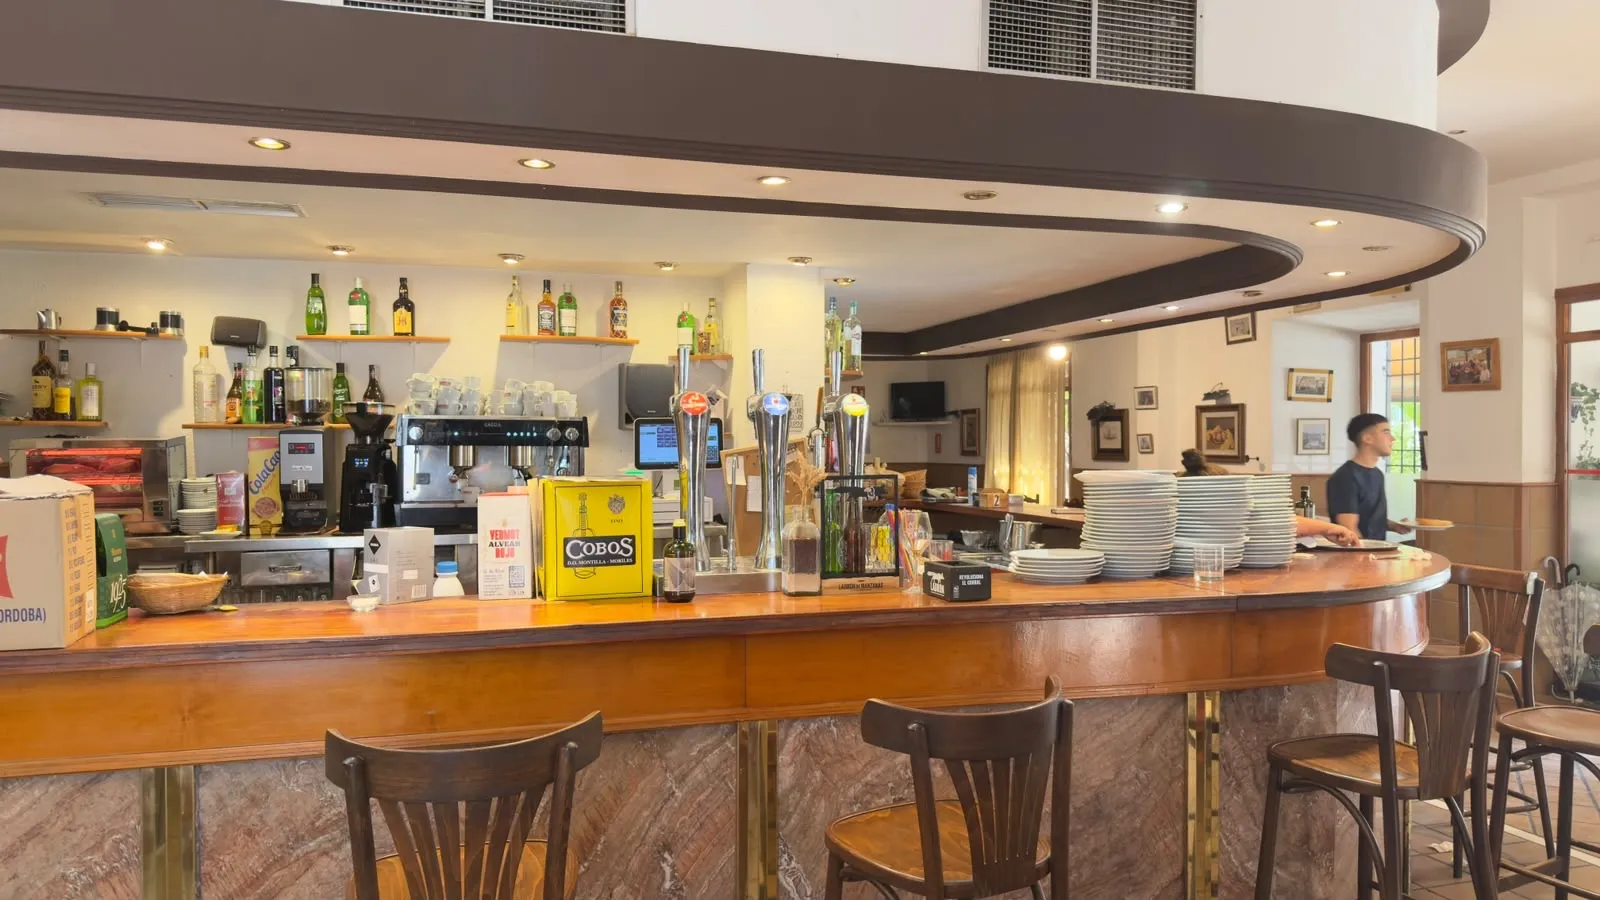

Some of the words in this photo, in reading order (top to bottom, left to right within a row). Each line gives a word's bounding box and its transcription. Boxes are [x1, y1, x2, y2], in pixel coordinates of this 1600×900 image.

[994, 494, 1000, 507] 2
[489, 529, 520, 540] VERMUT
[488, 540, 521, 548] ALVEAR
[495, 548, 515, 559] ROJO
